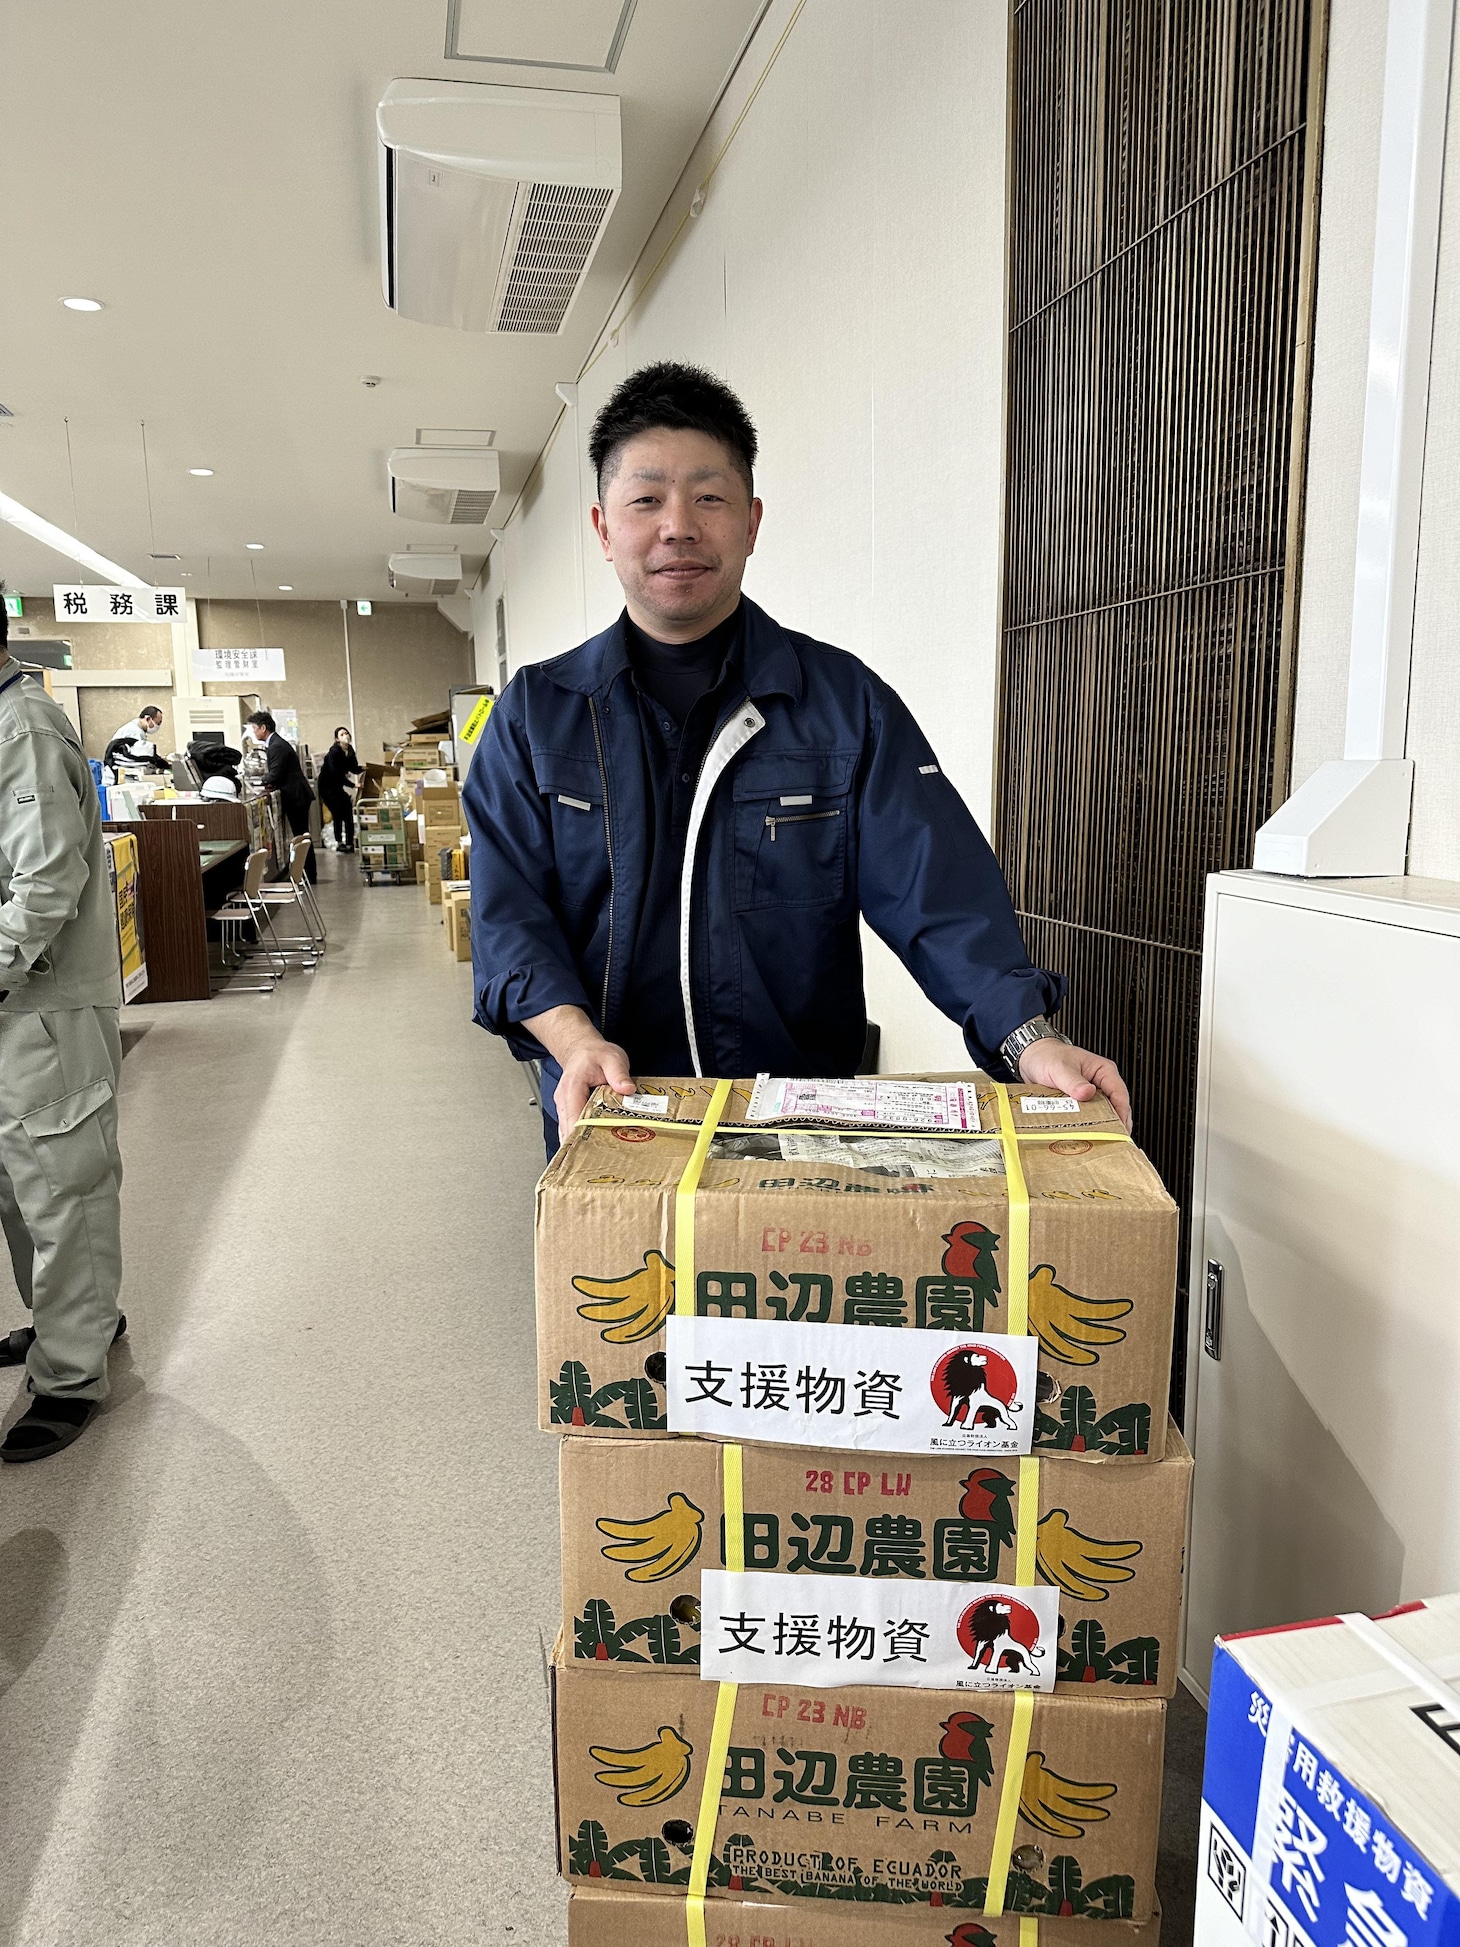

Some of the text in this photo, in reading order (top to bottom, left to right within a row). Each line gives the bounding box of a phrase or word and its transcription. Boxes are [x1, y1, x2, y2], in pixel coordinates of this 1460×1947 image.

[63, 592, 179, 616] 税務課
[799, 1231, 830, 1254] 23
[697, 1271, 985, 1332] 田辺農園
[685, 1361, 903, 1420] 支援物資
[930, 1438, 1019, 1449] 風に立つライオン基金
[805, 1470, 834, 1494] 28
[843, 1471, 871, 1495] CP
[720, 1512, 1000, 1582] 田辺農園
[718, 1611, 931, 1663] 支援物資
[762, 1694, 868, 1730] CP 23 NB
[721, 1746, 980, 1817] 田辺農園
[718, 1804, 972, 1834] TANABE FARM
[1247, 1691, 1435, 1922] 災用救援物資
[732, 1864, 964, 1892] THE BEST BANANA OF THE WORLD
[733, 1849, 962, 1879] PRODUCT OF ECUADOR
